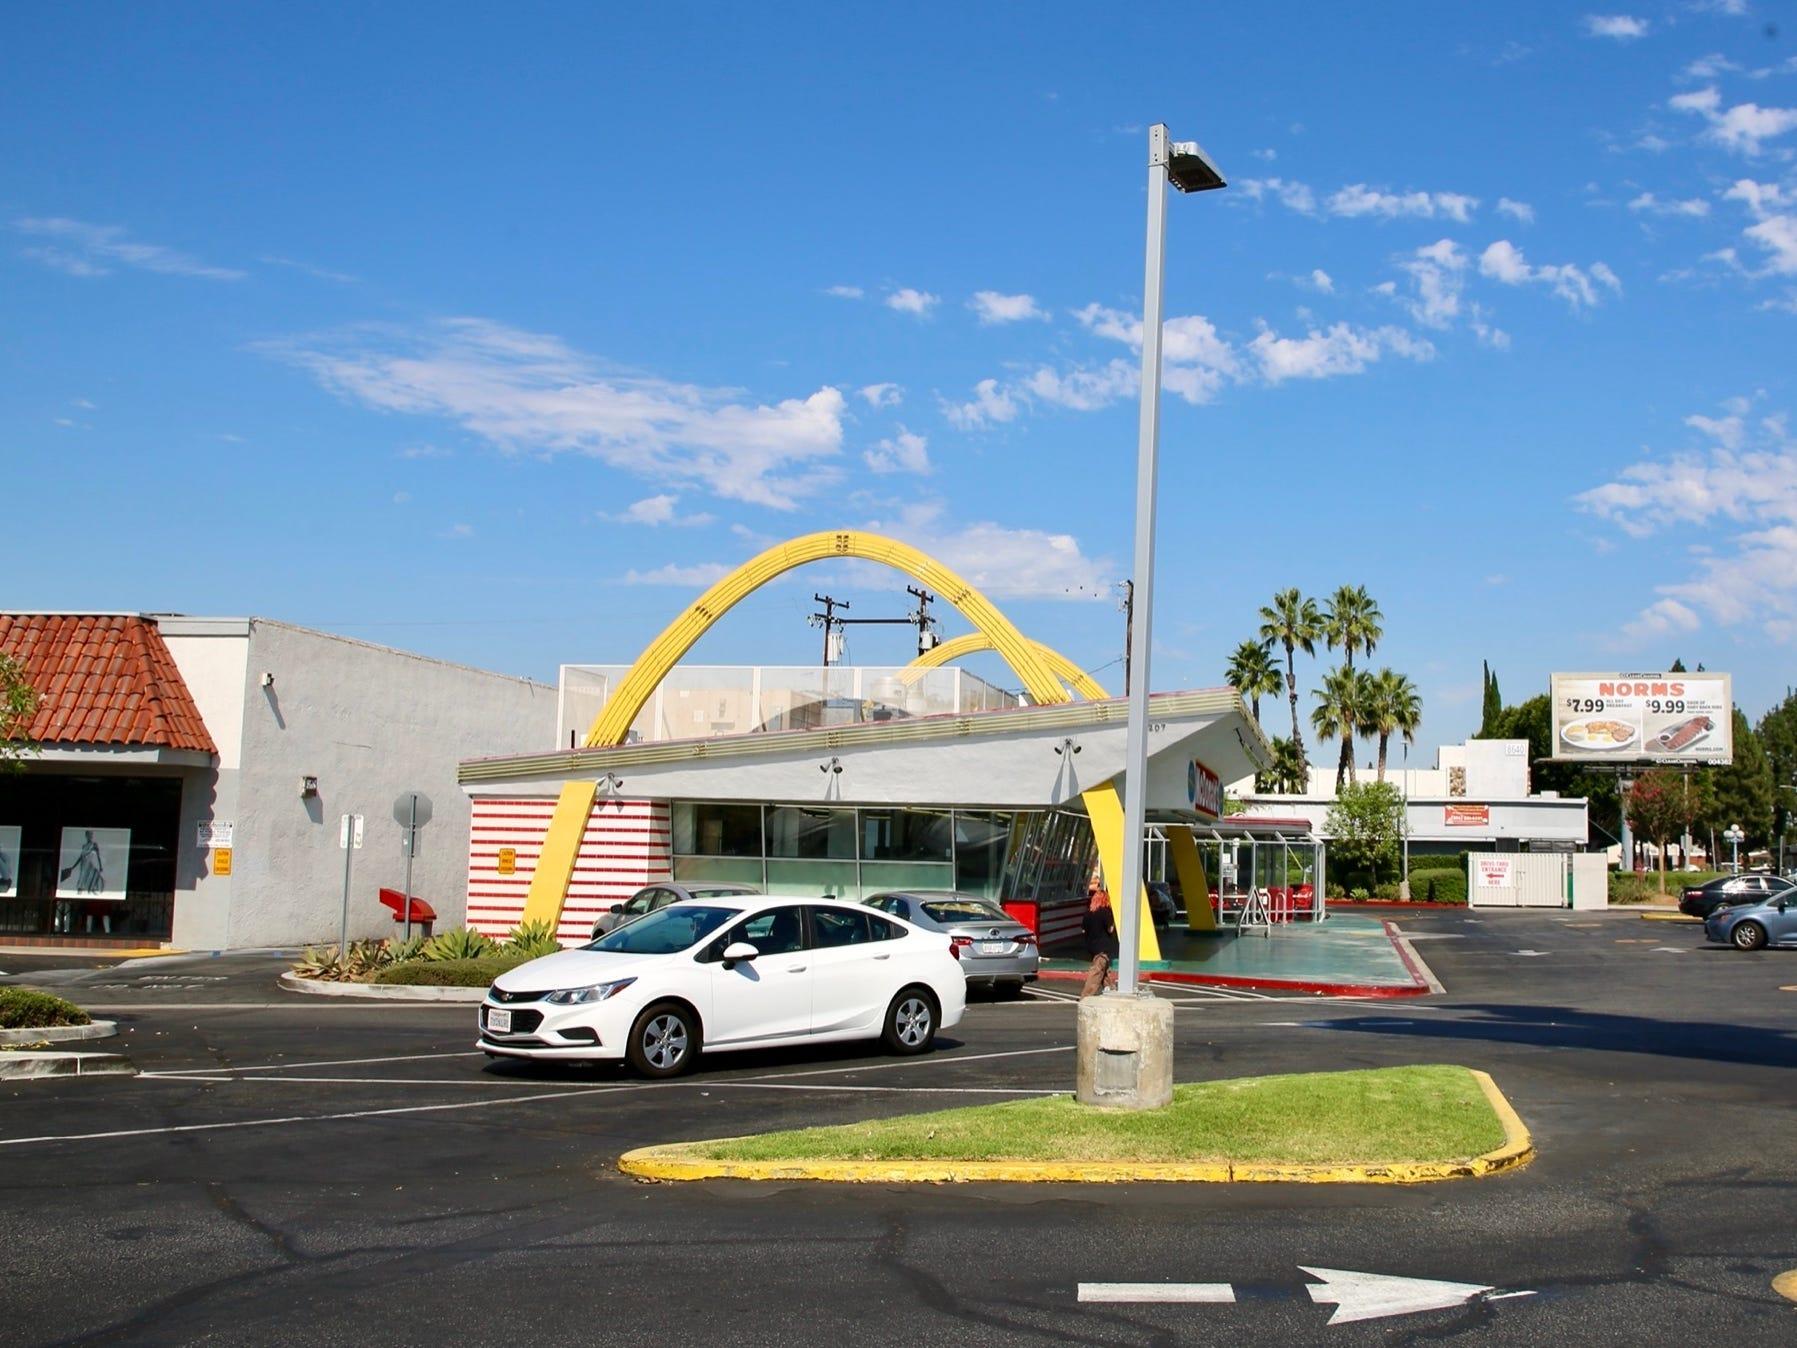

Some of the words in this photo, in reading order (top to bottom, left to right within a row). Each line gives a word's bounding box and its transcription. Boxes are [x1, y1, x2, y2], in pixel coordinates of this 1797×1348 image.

[1600, 683, 1685, 697] NORMS
[1567, 699, 1604, 713] $7.99
[1646, 700, 1685, 713] $9.99
[1507, 745, 1524, 754] 8640
